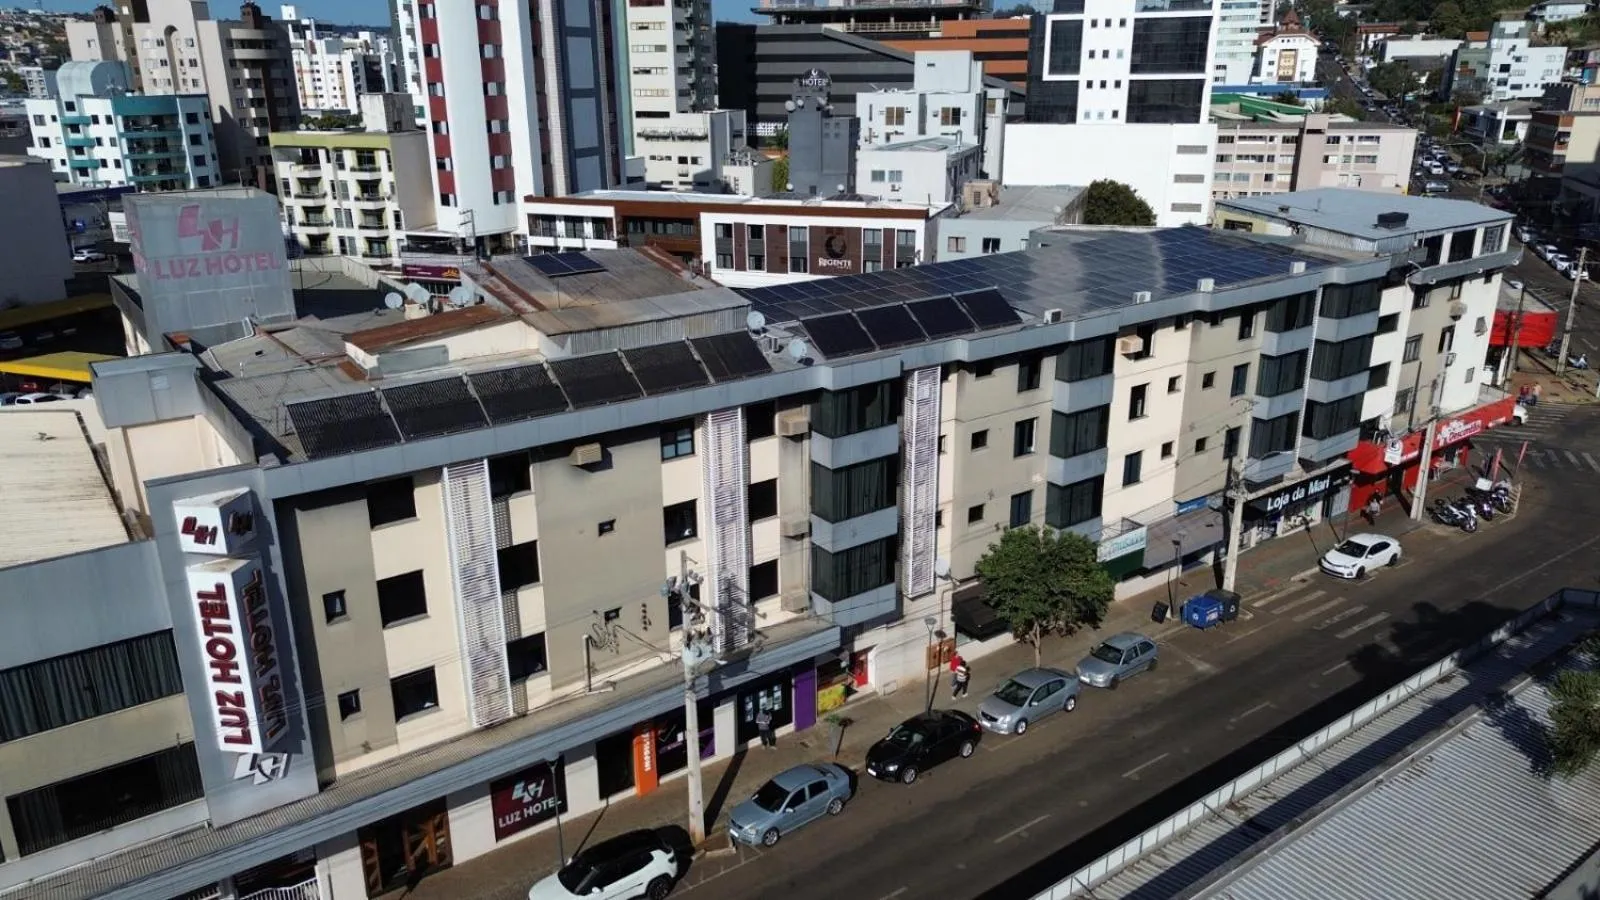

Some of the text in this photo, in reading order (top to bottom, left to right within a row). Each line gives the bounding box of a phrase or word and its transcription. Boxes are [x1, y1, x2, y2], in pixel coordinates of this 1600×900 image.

[154, 252, 281, 280] LUZ HOTEL
[1267, 492, 1290, 511] Loja
[1292, 487, 1305, 501] da
[1308, 475, 1330, 496] Mari
[197, 582, 243, 684] HOTEL
[242, 568, 277, 678] HOTEL
[215, 690, 253, 745] LUZ
[498, 811, 522, 828] LUZ
